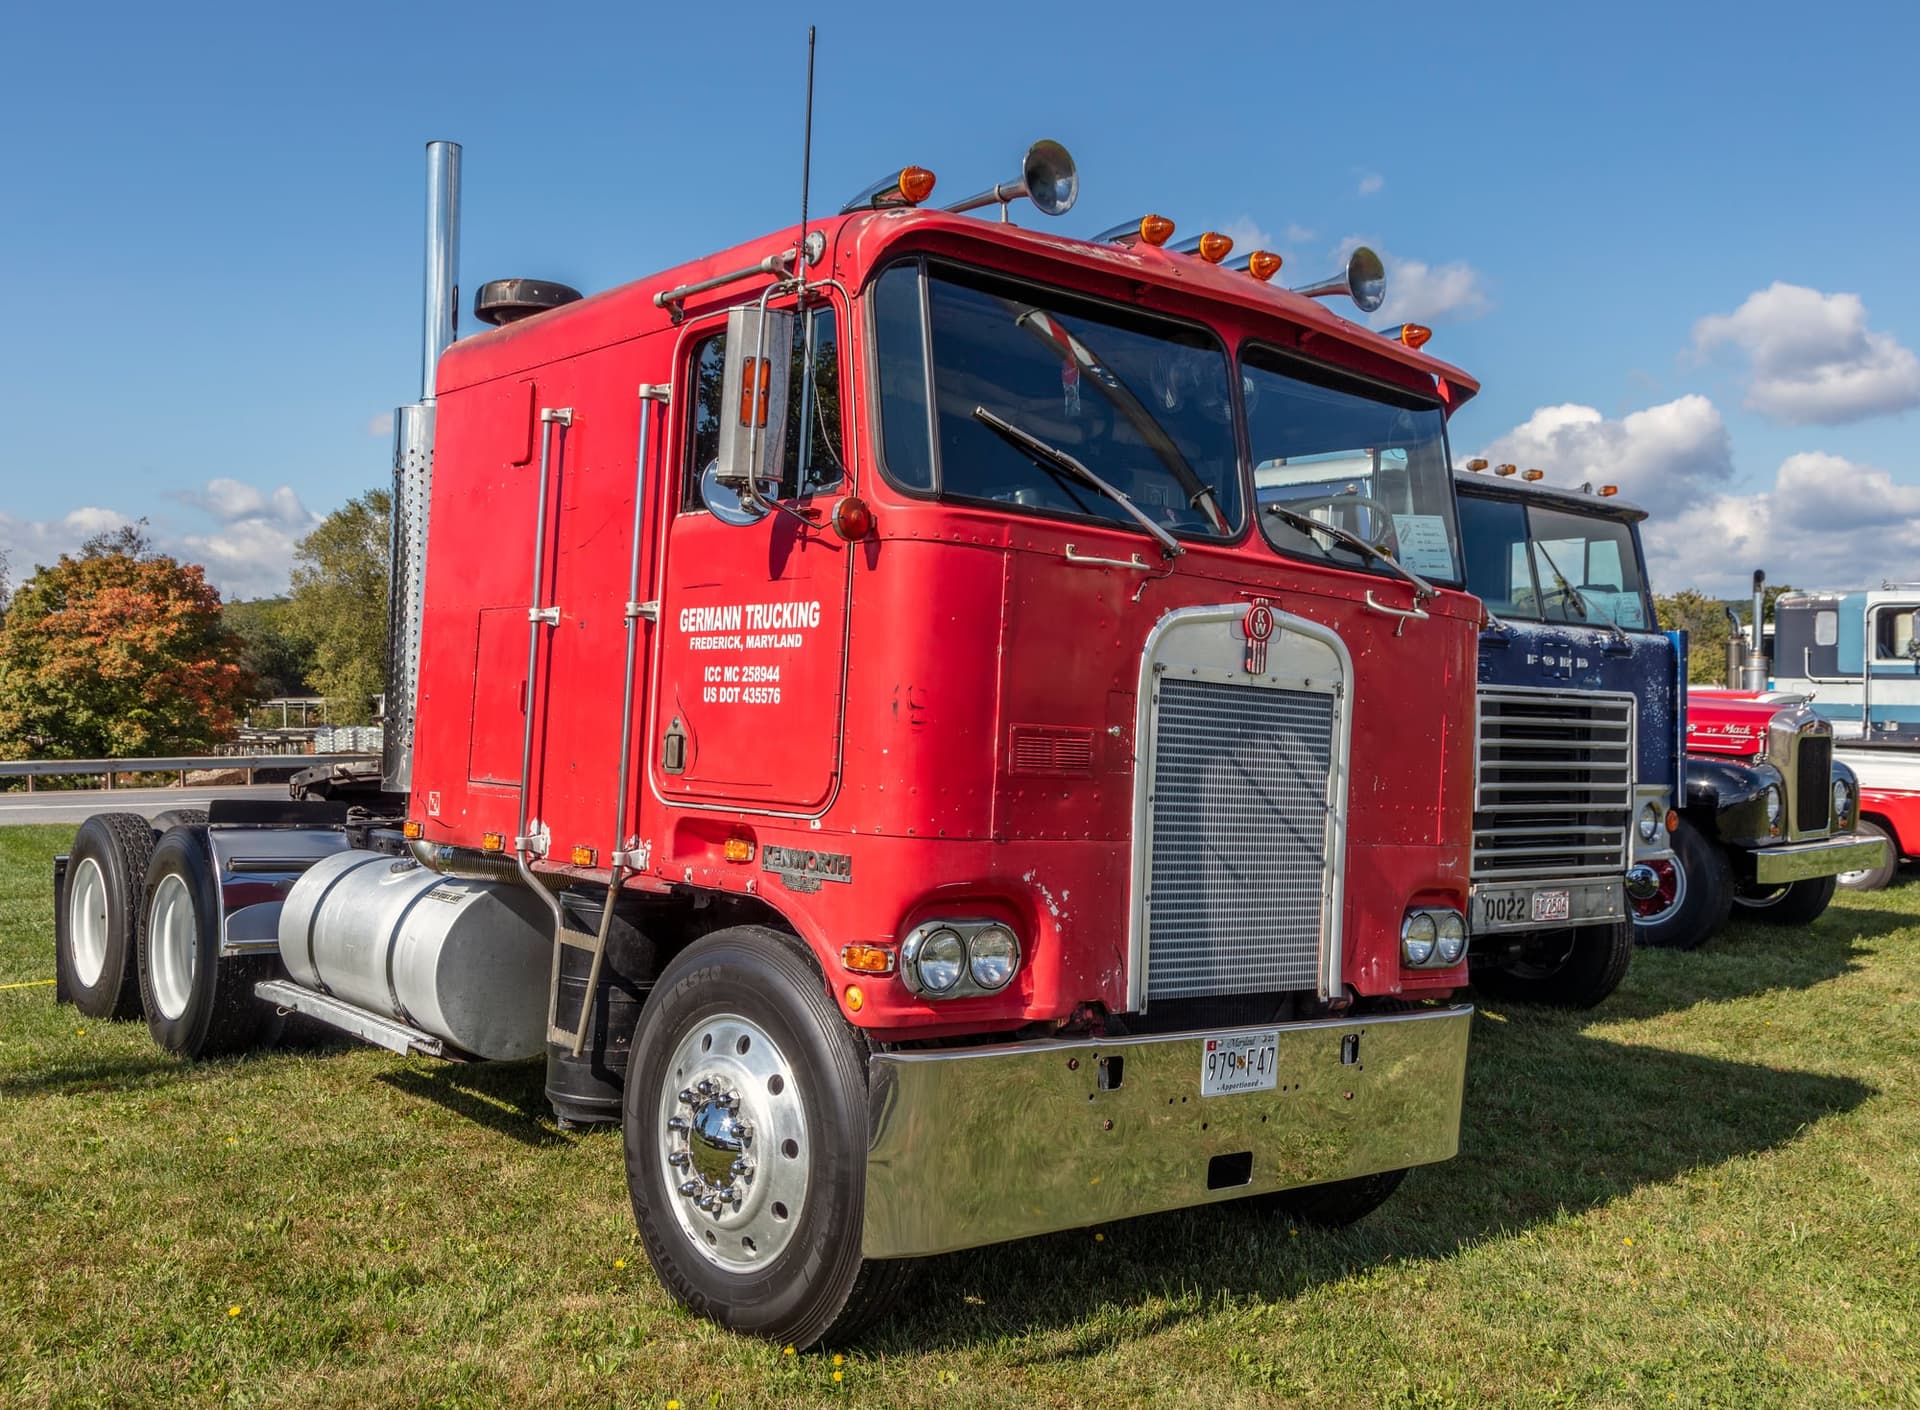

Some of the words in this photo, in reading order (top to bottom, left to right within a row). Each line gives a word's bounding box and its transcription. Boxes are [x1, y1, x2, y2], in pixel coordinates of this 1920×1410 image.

[680, 605, 742, 632] GERMANN
[745, 601, 820, 630] TRUCKING
[689, 636, 743, 651] FREDERICK,
[746, 634, 803, 649] MARYLAND
[1527, 654, 1588, 668] FORD
[704, 666, 721, 682] ICC
[724, 666, 739, 682] MC
[742, 665, 780, 682] 258944
[703, 687, 717, 702] US
[719, 687, 740, 703] DOT
[742, 687, 780, 704] 435576
[1721, 723, 1751, 735] Mack
[762, 845, 852, 876] KENWORTH
[1486, 897, 1525, 921] 0022
